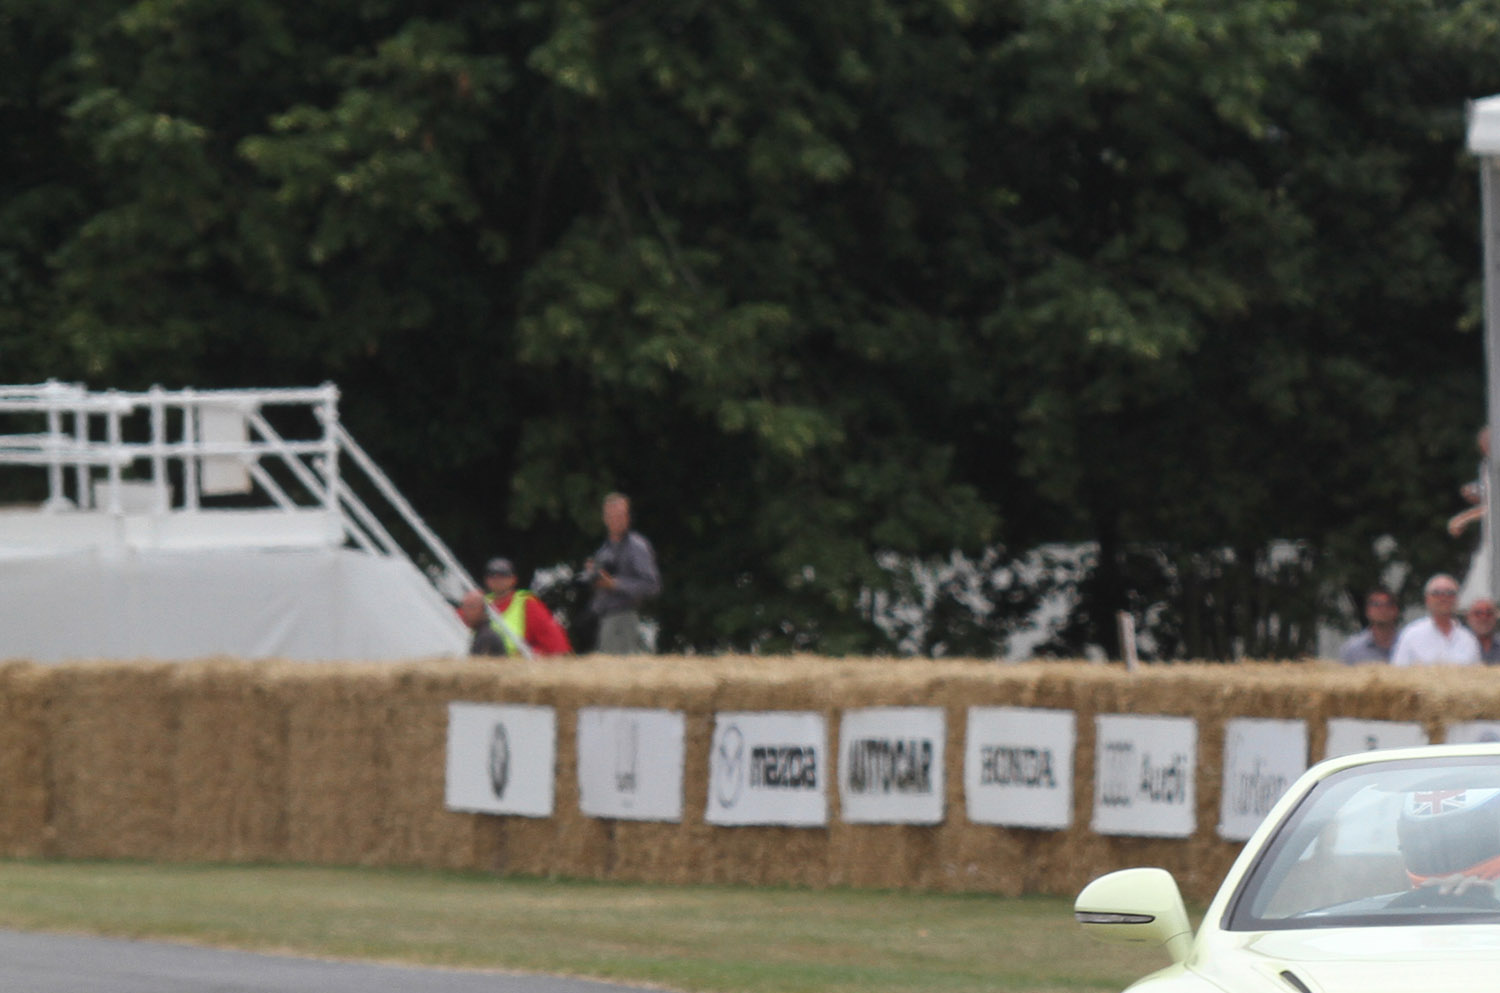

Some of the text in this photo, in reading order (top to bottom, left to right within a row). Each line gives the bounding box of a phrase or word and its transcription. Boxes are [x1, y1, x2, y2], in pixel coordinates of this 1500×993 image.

[750, 744, 817, 790] mazda
[848, 737, 933, 795] AUTOCAR
[980, 745, 1056, 789] HONDA
[1141, 751, 1186, 805] Audi
